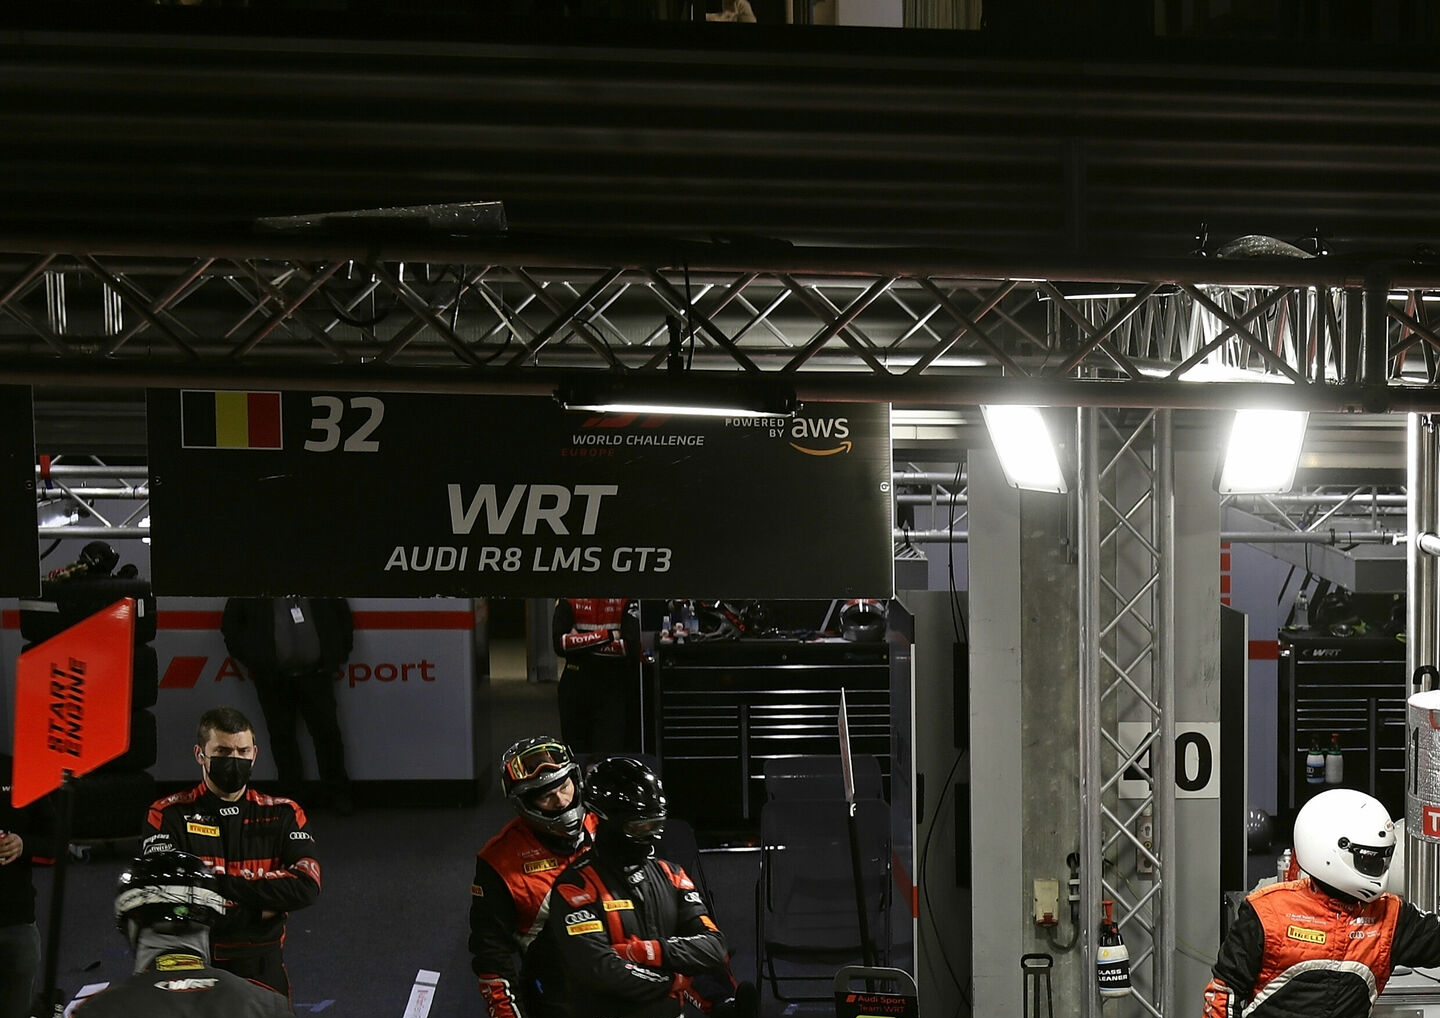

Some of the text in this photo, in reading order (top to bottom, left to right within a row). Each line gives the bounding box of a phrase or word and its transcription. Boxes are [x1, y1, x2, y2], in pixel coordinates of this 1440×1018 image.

[303, 396, 386, 453] 32
[725, 417, 850, 439] POWERED aws
[768, 428, 785, 438] BY
[572, 434, 705, 447] WORLD CHALLENGE
[561, 448, 616, 458] EUROPE
[447, 483, 619, 536] WRT
[384, 546, 673, 574] AUDI R8 LMS GT3
[570, 634, 602, 644] TOTAL
[1312, 648, 1343, 657] WRT
[1288, 927, 1325, 943] PIRELLI
[1098, 975, 1128, 983] LEANER
[858, 994, 907, 1005] Audi Sport
